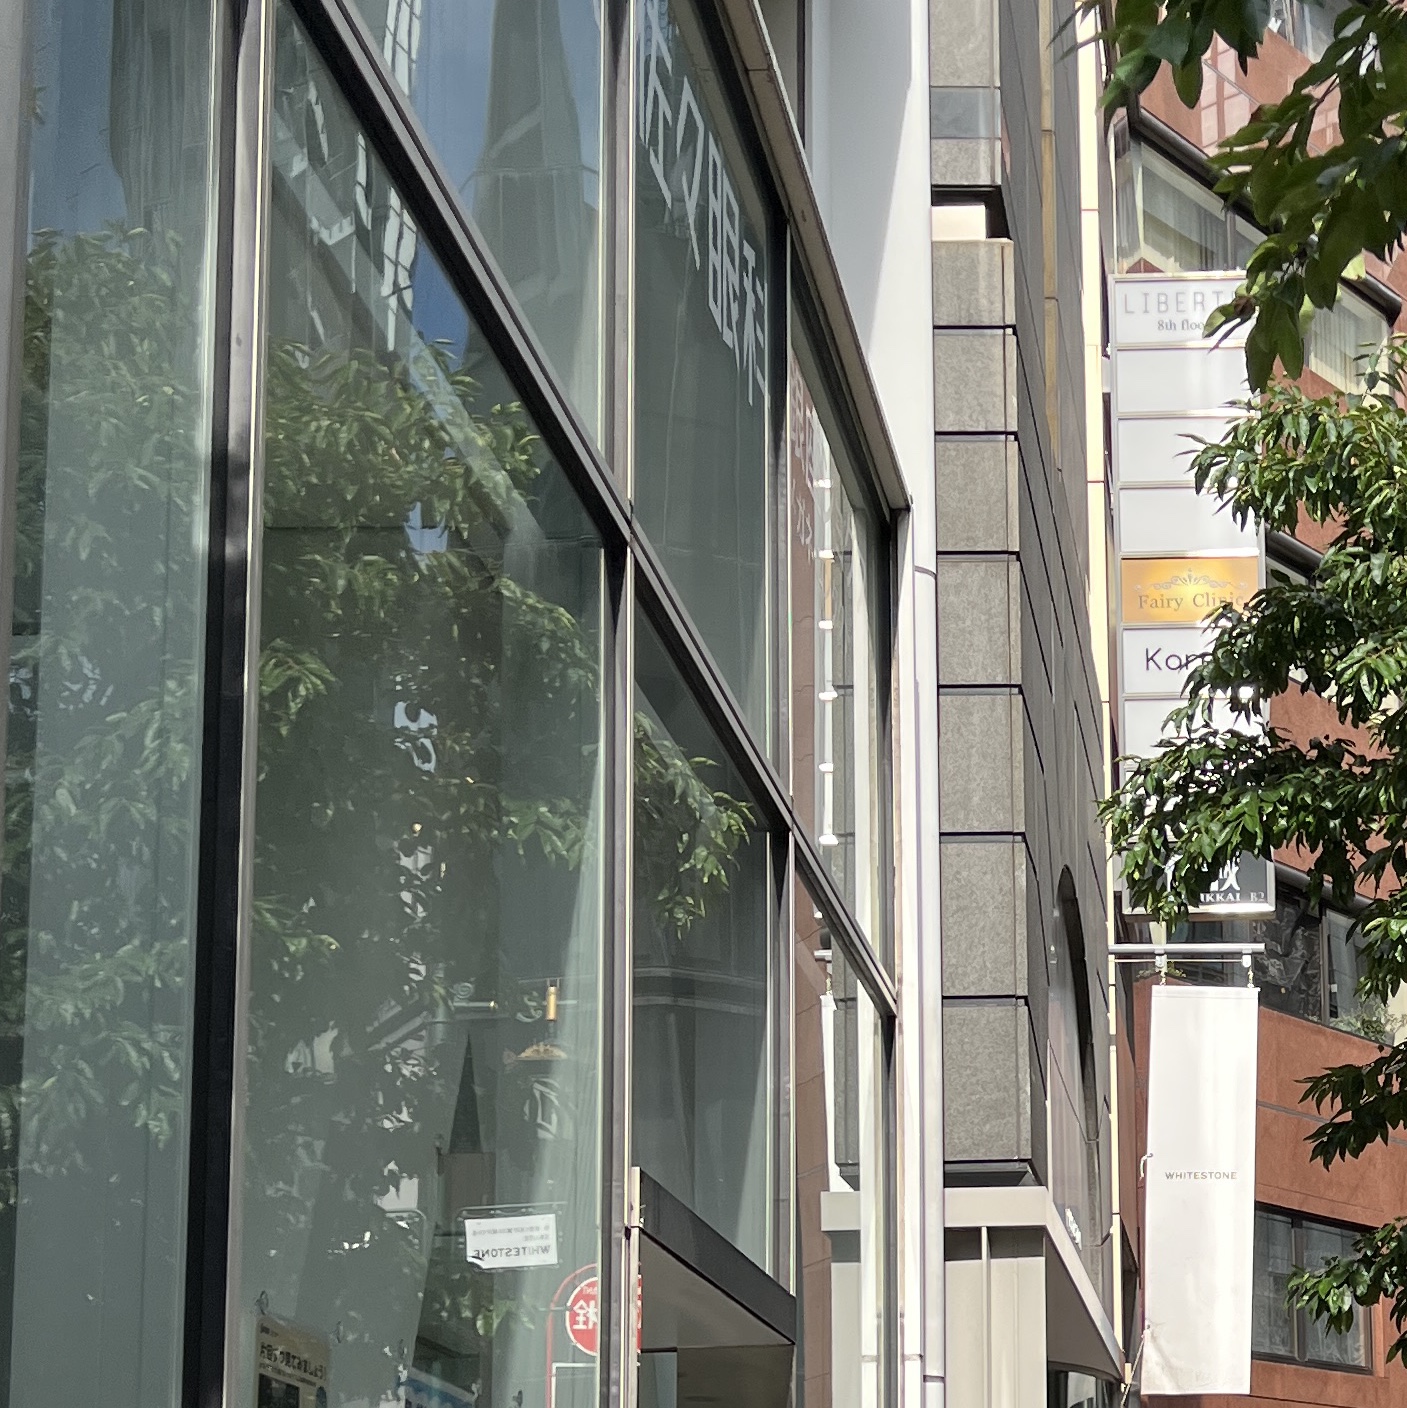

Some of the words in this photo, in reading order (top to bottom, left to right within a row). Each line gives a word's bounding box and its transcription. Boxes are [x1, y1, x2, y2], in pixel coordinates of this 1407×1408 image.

[1124, 290, 1235, 314] LIBERT
[1157, 319, 1177, 331] 8th
[1138, 594, 1183, 611] Fairy
[1164, 1171, 1238, 1180] WHITESTONE
